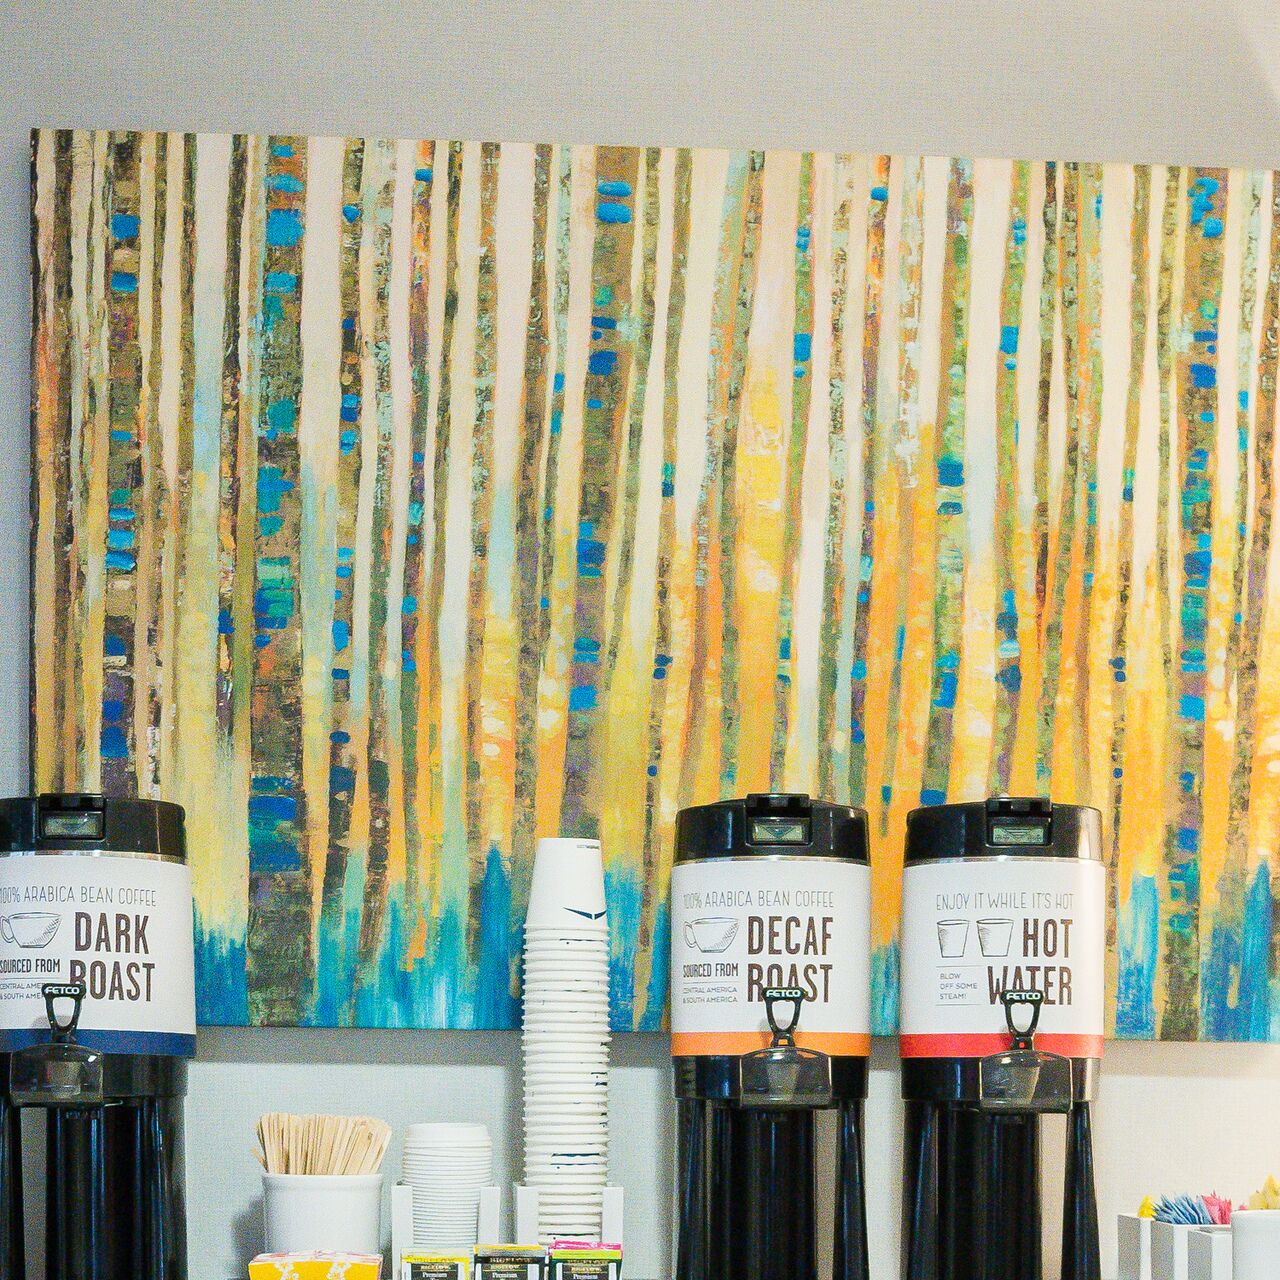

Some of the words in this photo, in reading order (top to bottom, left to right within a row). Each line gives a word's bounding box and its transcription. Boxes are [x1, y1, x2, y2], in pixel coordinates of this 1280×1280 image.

[0, 886, 20, 904] 100%
[24, 885, 75, 903] ARABICA
[81, 886, 113, 904] BEAN
[119, 888, 156, 907] COFFEE
[705, 890, 753, 908] ARABICA
[758, 890, 790, 907] BEAN
[795, 890, 834, 908] COFFEE
[936, 894, 970, 911] ENJOY
[975, 893, 984, 909] IT
[988, 892, 1027, 909] WHILE
[1032, 893, 1052, 909] IT'S
[1056, 893, 1075, 910] HOT
[75, 912, 150, 955] DARK
[747, 916, 834, 956] DECAF
[1022, 918, 1073, 958] HOT
[0, 959, 32, 974] SOURCED
[35, 958, 61, 973] FROM
[683, 963, 712, 978] SOURCED
[715, 962, 739, 977] FROM
[0, 983, 24, 991] CENTRAL
[44, 986, 80, 995] FETCO
[747, 963, 833, 1003] ROAST
[956, 982, 977, 990] SOME
[987, 966, 1073, 1006] WATER
[765, 989, 801, 998] FETCO
[1006, 991, 1041, 1000] FETCO
